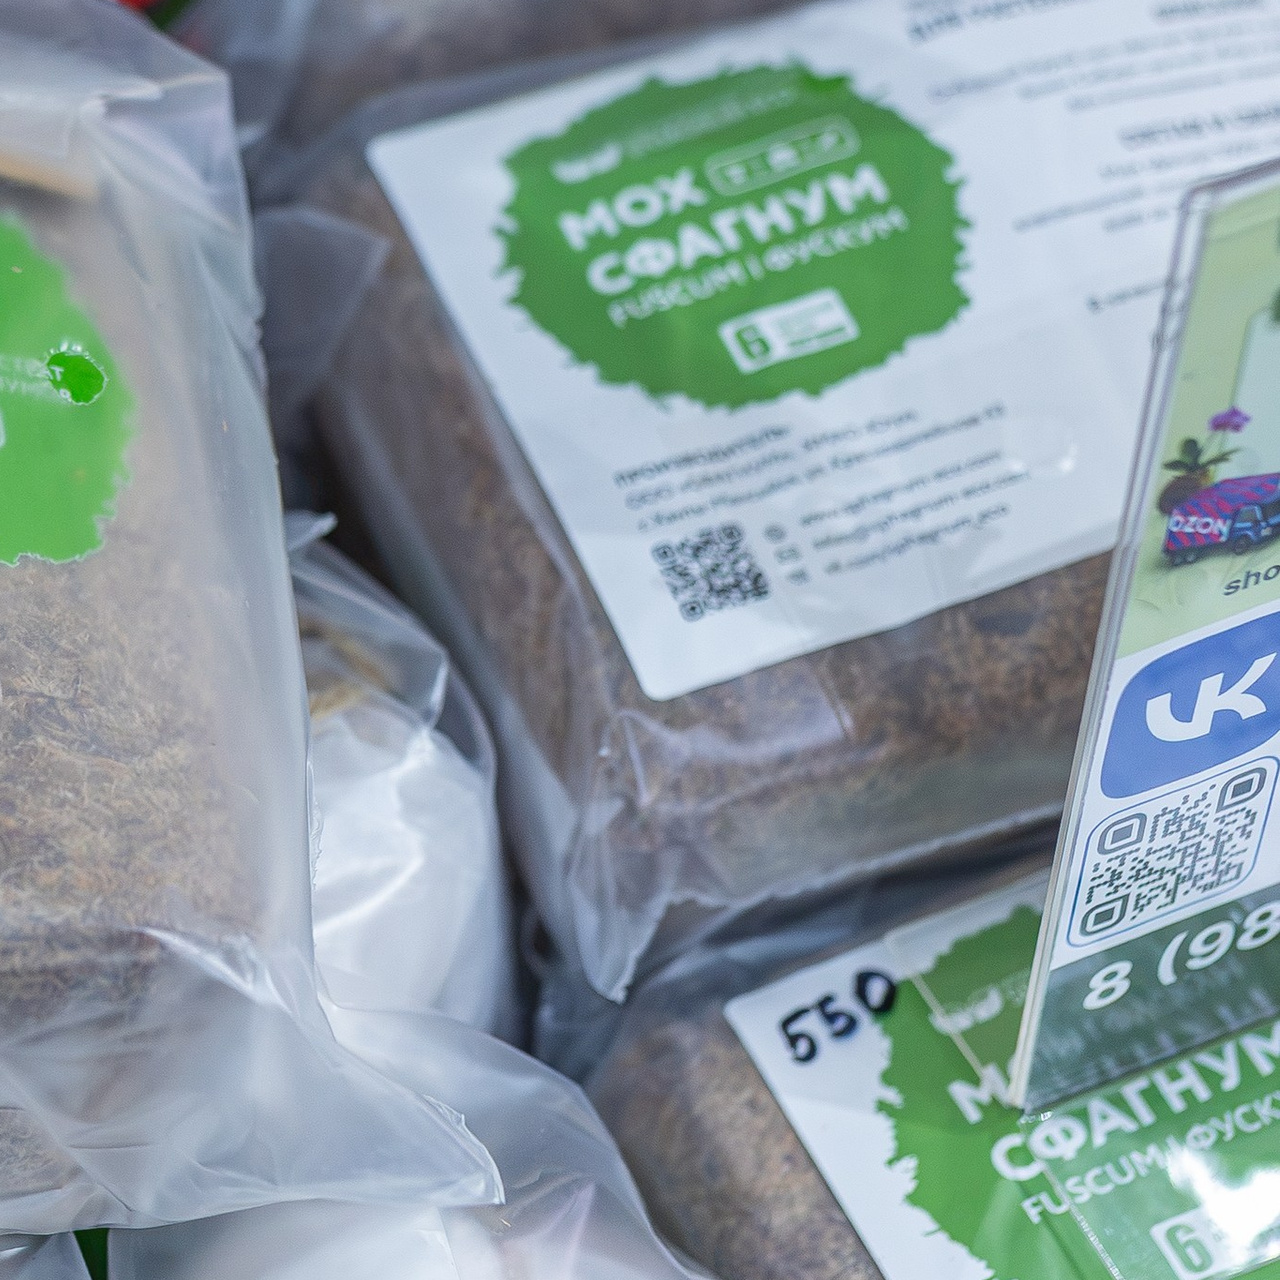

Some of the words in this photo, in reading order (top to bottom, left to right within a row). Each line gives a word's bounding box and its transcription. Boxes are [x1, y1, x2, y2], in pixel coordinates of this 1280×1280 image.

[559, 166, 709, 252] МОХ
[586, 162, 889, 296] СФАГНУМ
[1082, 960, 1133, 1010] 8
[1022, 1144, 1172, 1224] FUSCUM
[1165, 1224, 1214, 1273] 6
